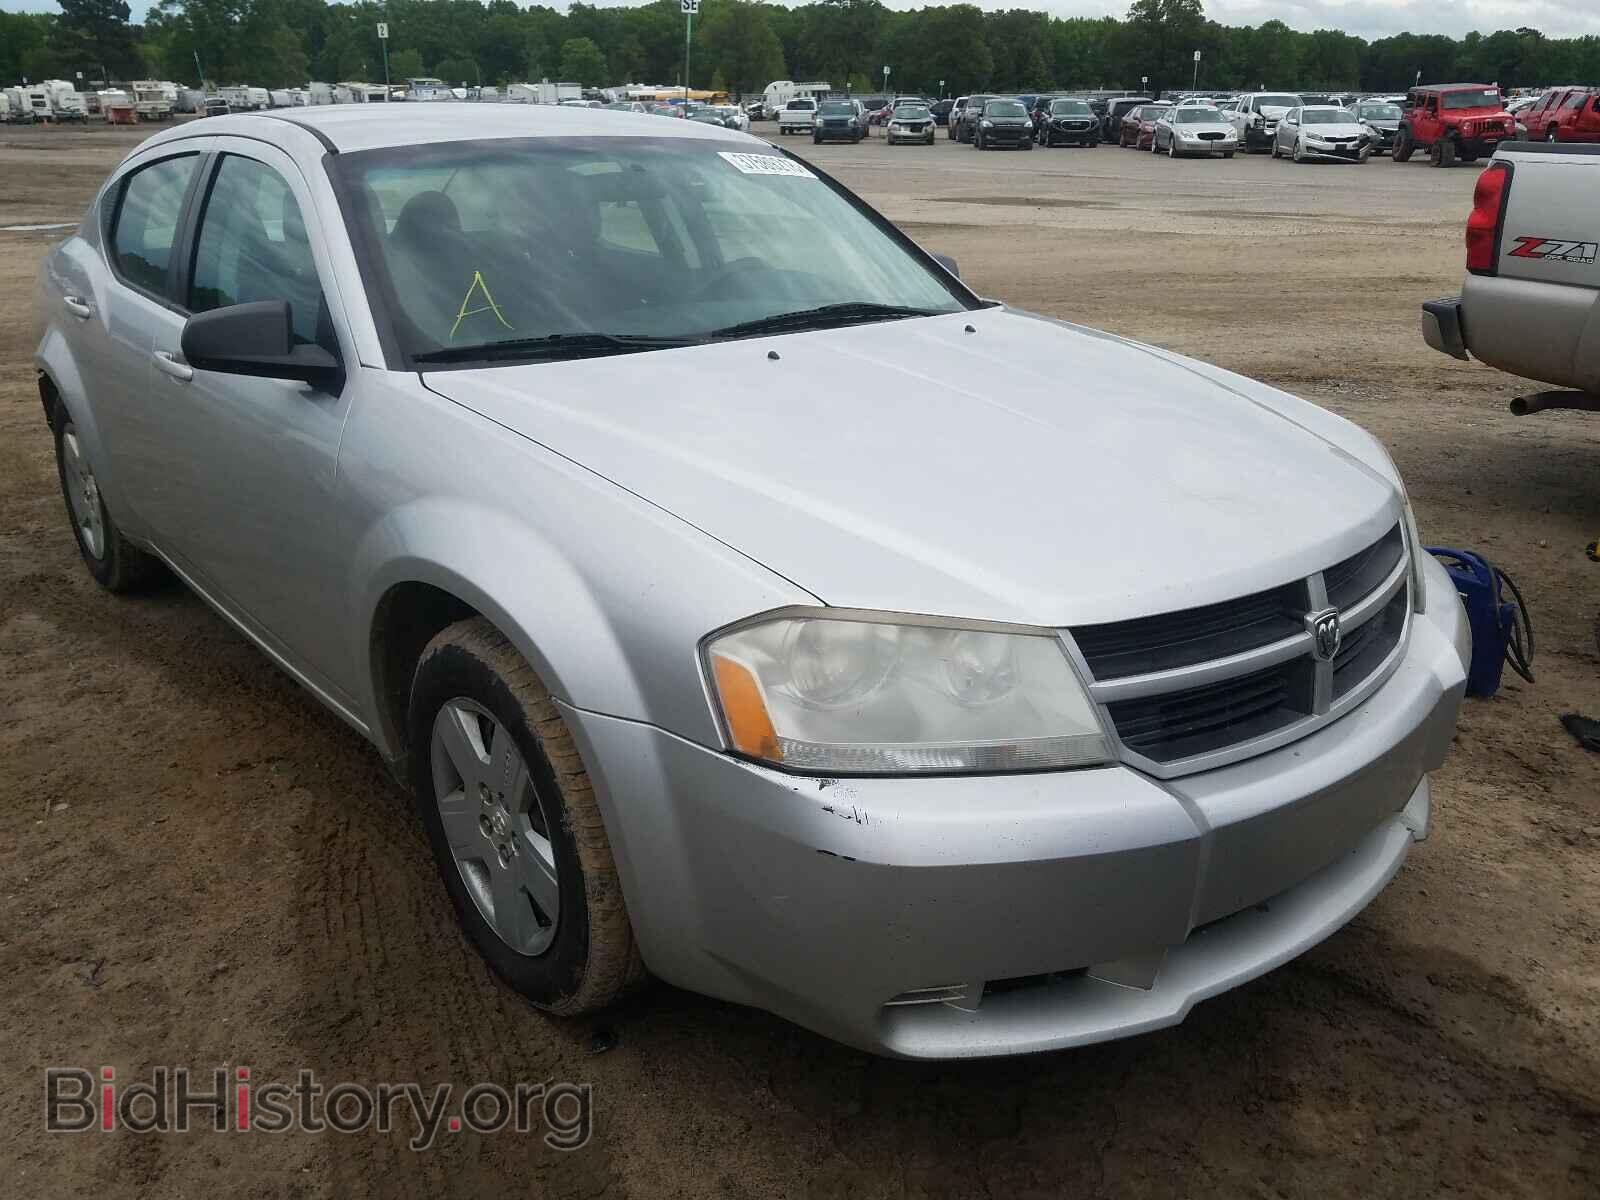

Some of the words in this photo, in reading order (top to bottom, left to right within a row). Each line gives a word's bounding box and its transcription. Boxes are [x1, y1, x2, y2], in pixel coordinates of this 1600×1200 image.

[1507, 237, 1599, 260] Z71
[1565, 256, 1594, 265] ROAD
[450, 270, 515, 341] A
